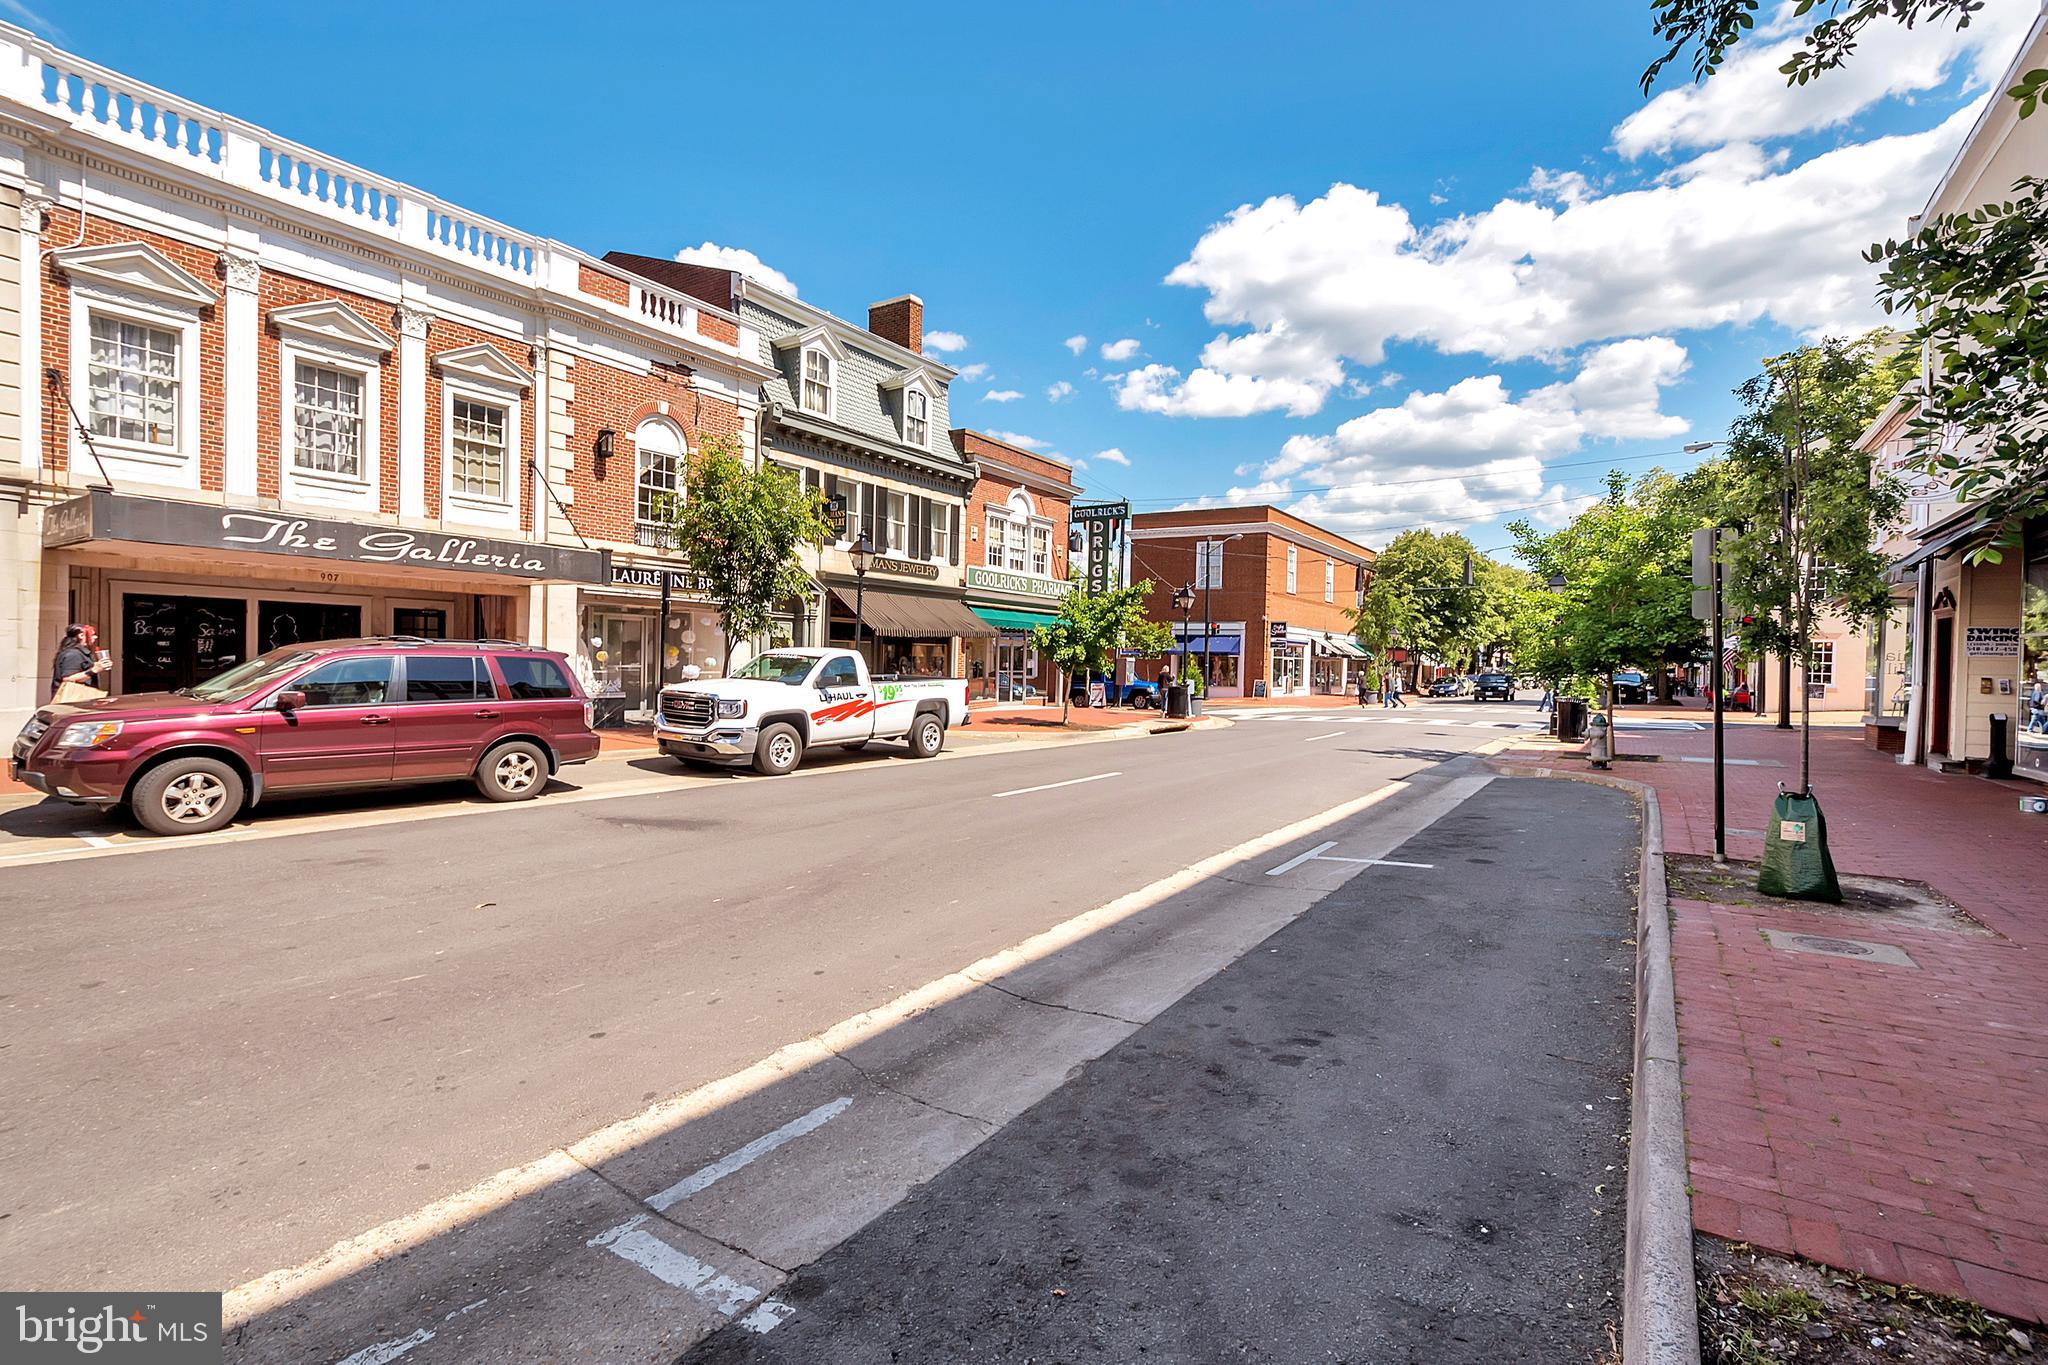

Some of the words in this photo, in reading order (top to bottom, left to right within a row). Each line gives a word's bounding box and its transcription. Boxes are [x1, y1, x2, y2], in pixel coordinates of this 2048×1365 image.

[222, 514, 337, 550] The
[358, 532, 546, 571] Galleria
[1091, 521, 1104, 592] DRUGS
[320, 572, 339, 582] 907
[899, 562, 938, 576] JEWELRY
[1031, 579, 1072, 600] PHARMAC
